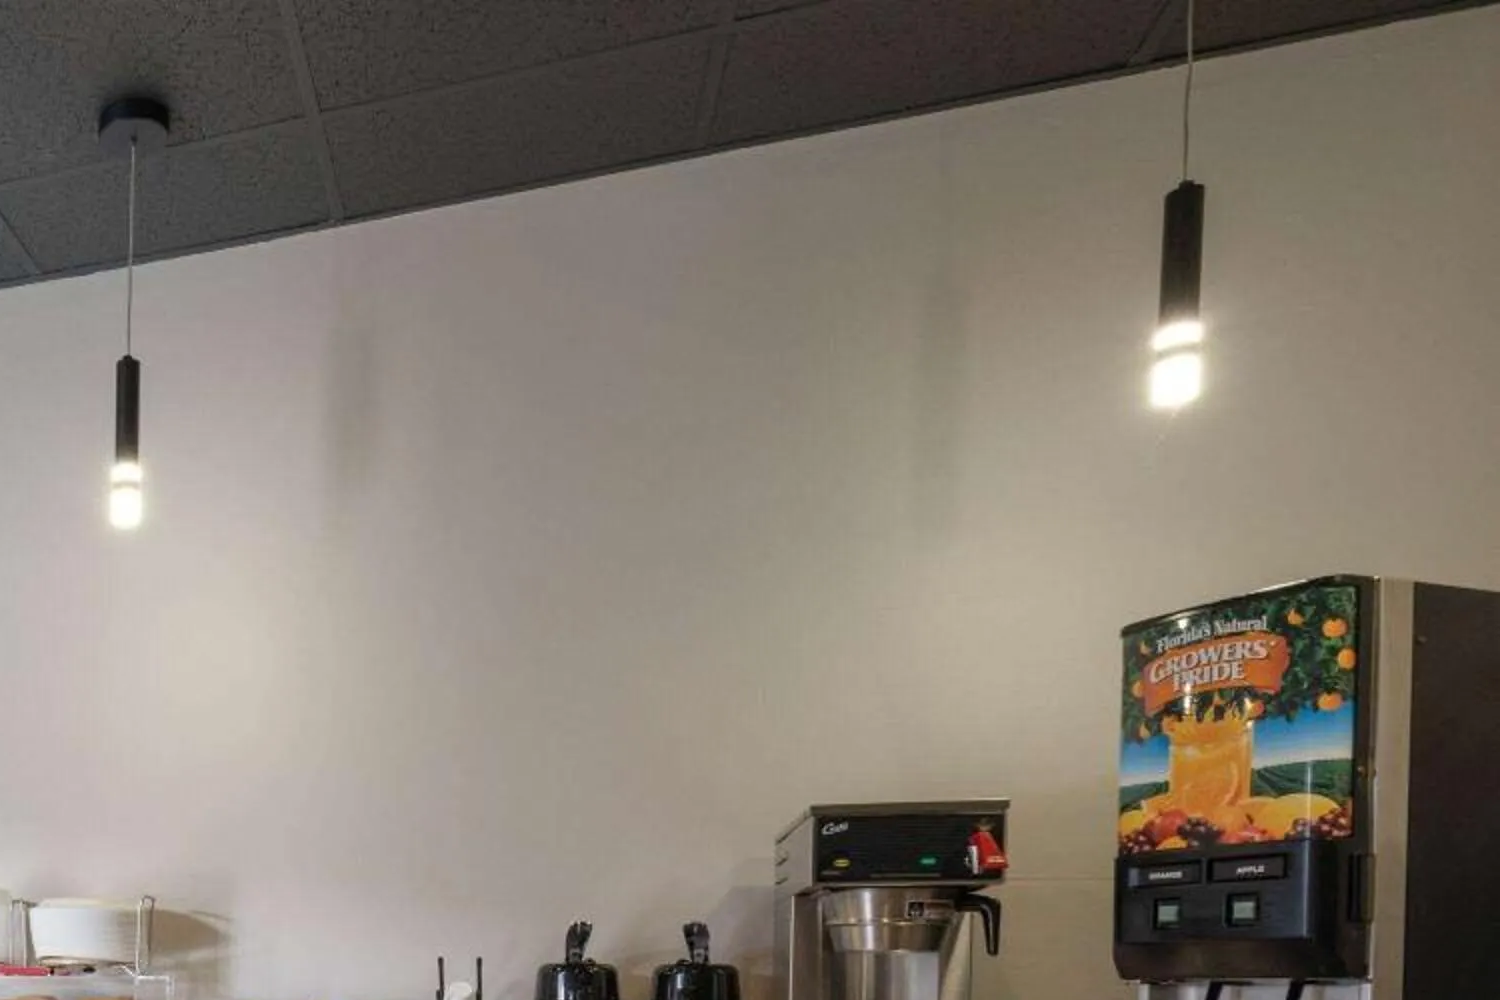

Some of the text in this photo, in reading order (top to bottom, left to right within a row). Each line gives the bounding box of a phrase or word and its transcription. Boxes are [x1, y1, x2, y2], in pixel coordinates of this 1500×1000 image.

[1156, 615, 1268, 653] Florida's Natural
[1173, 661, 1245, 692] PRIDE
